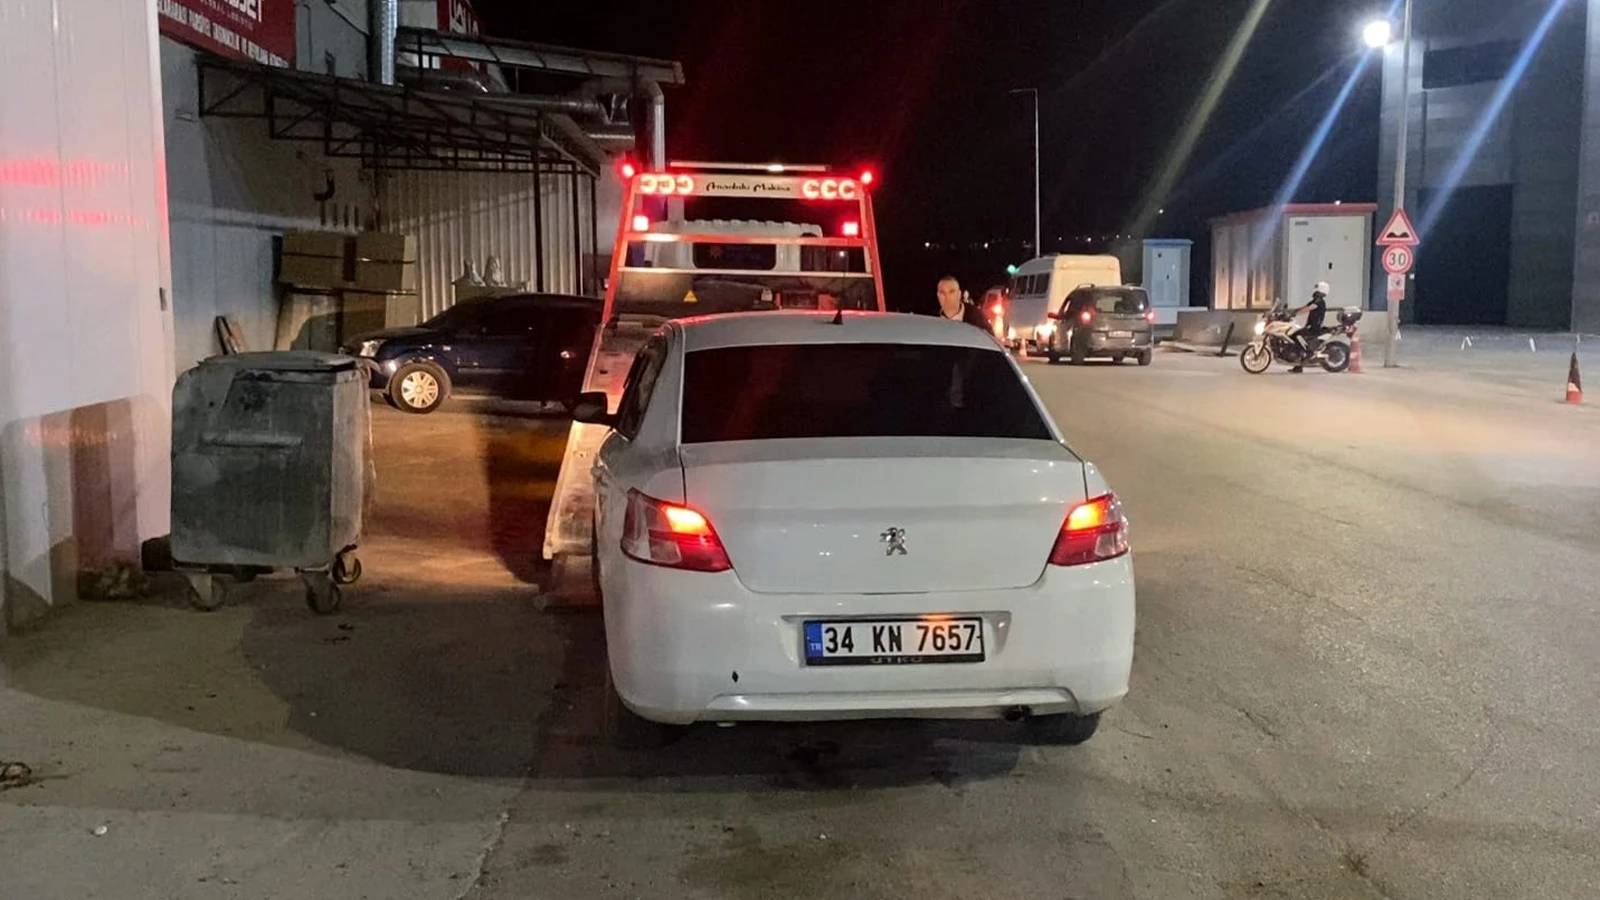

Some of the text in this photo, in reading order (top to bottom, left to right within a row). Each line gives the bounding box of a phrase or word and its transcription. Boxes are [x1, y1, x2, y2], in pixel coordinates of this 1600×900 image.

[706, 181, 791, 193] Anadolu Makina
[1388, 252, 1406, 266] 30
[824, 624, 976, 654] 34 KN 7657
